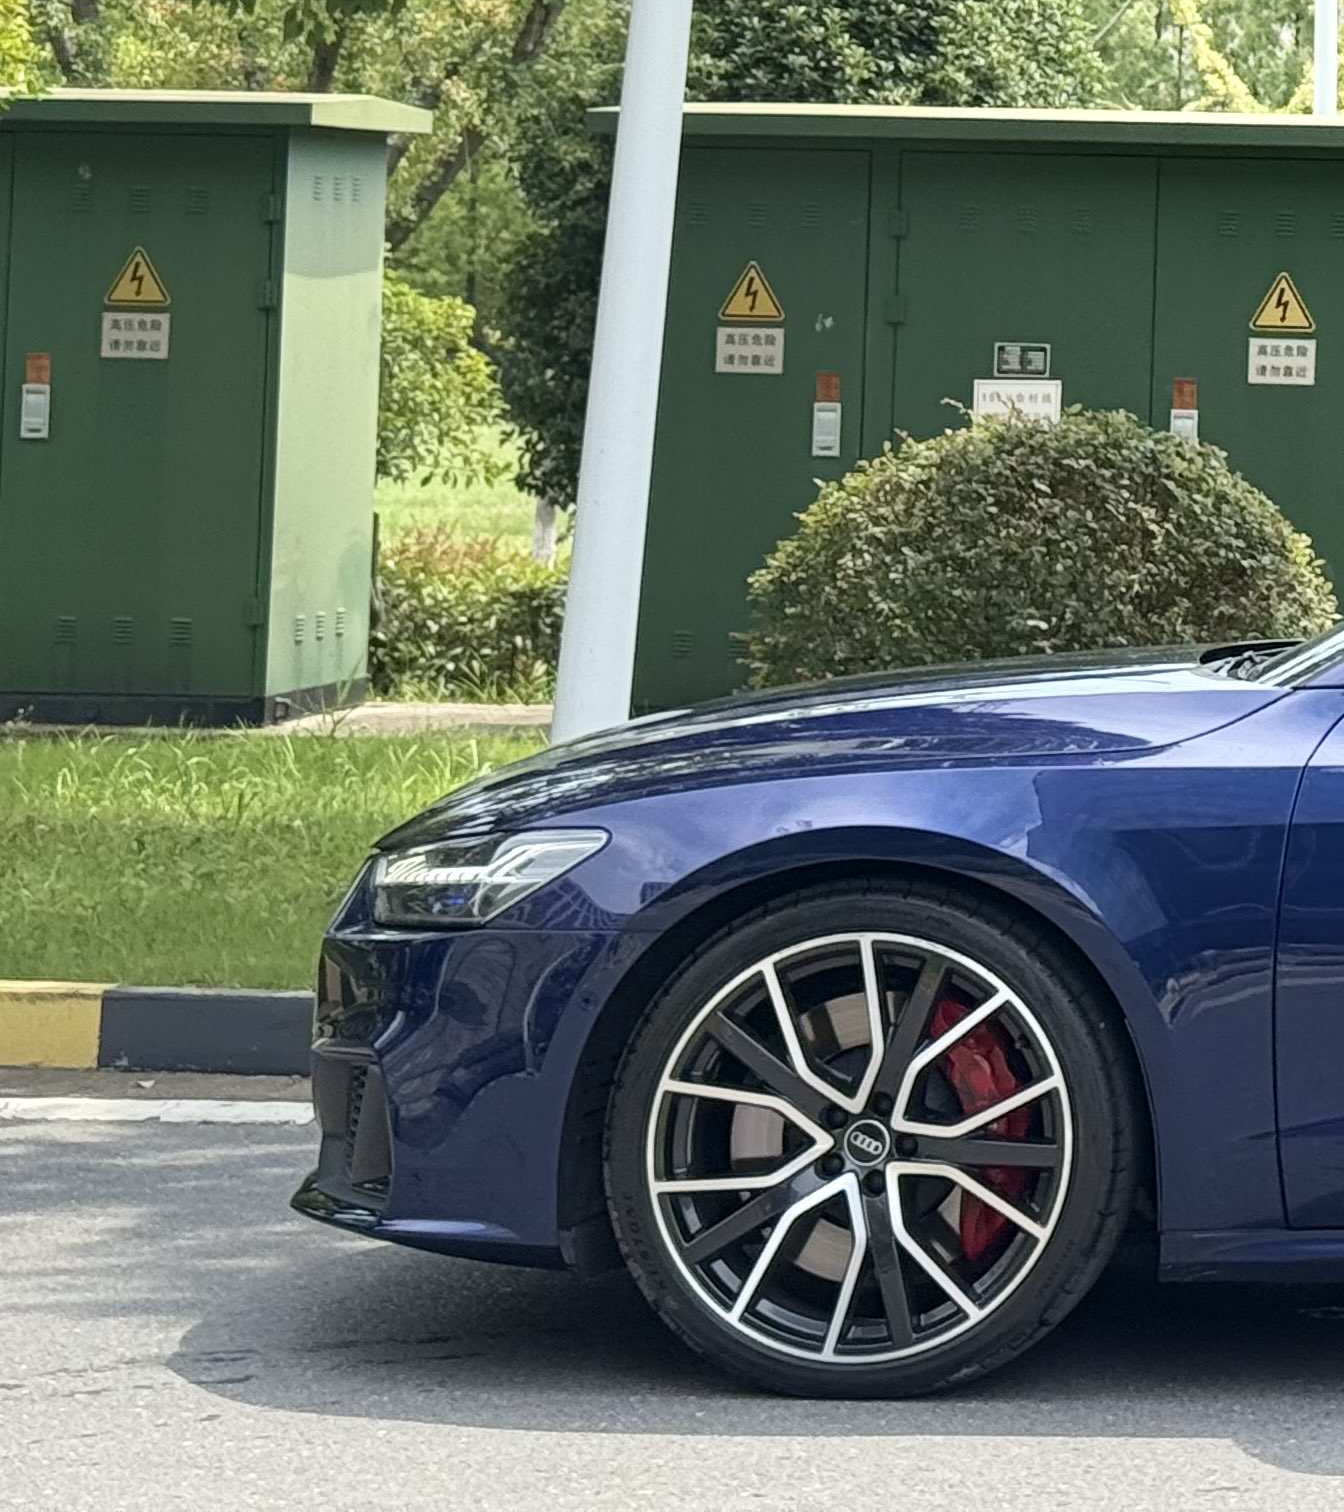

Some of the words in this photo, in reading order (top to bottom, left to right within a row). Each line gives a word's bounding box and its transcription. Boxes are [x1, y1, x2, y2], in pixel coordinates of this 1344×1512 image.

[109, 318, 162, 332] 高压危险
[724, 333, 776, 346] 高压危险
[1257, 344, 1309, 357] 高压危险
[723, 354, 775, 367] 请勿靠近
[1255, 364, 1307, 378] 请勿靠近
